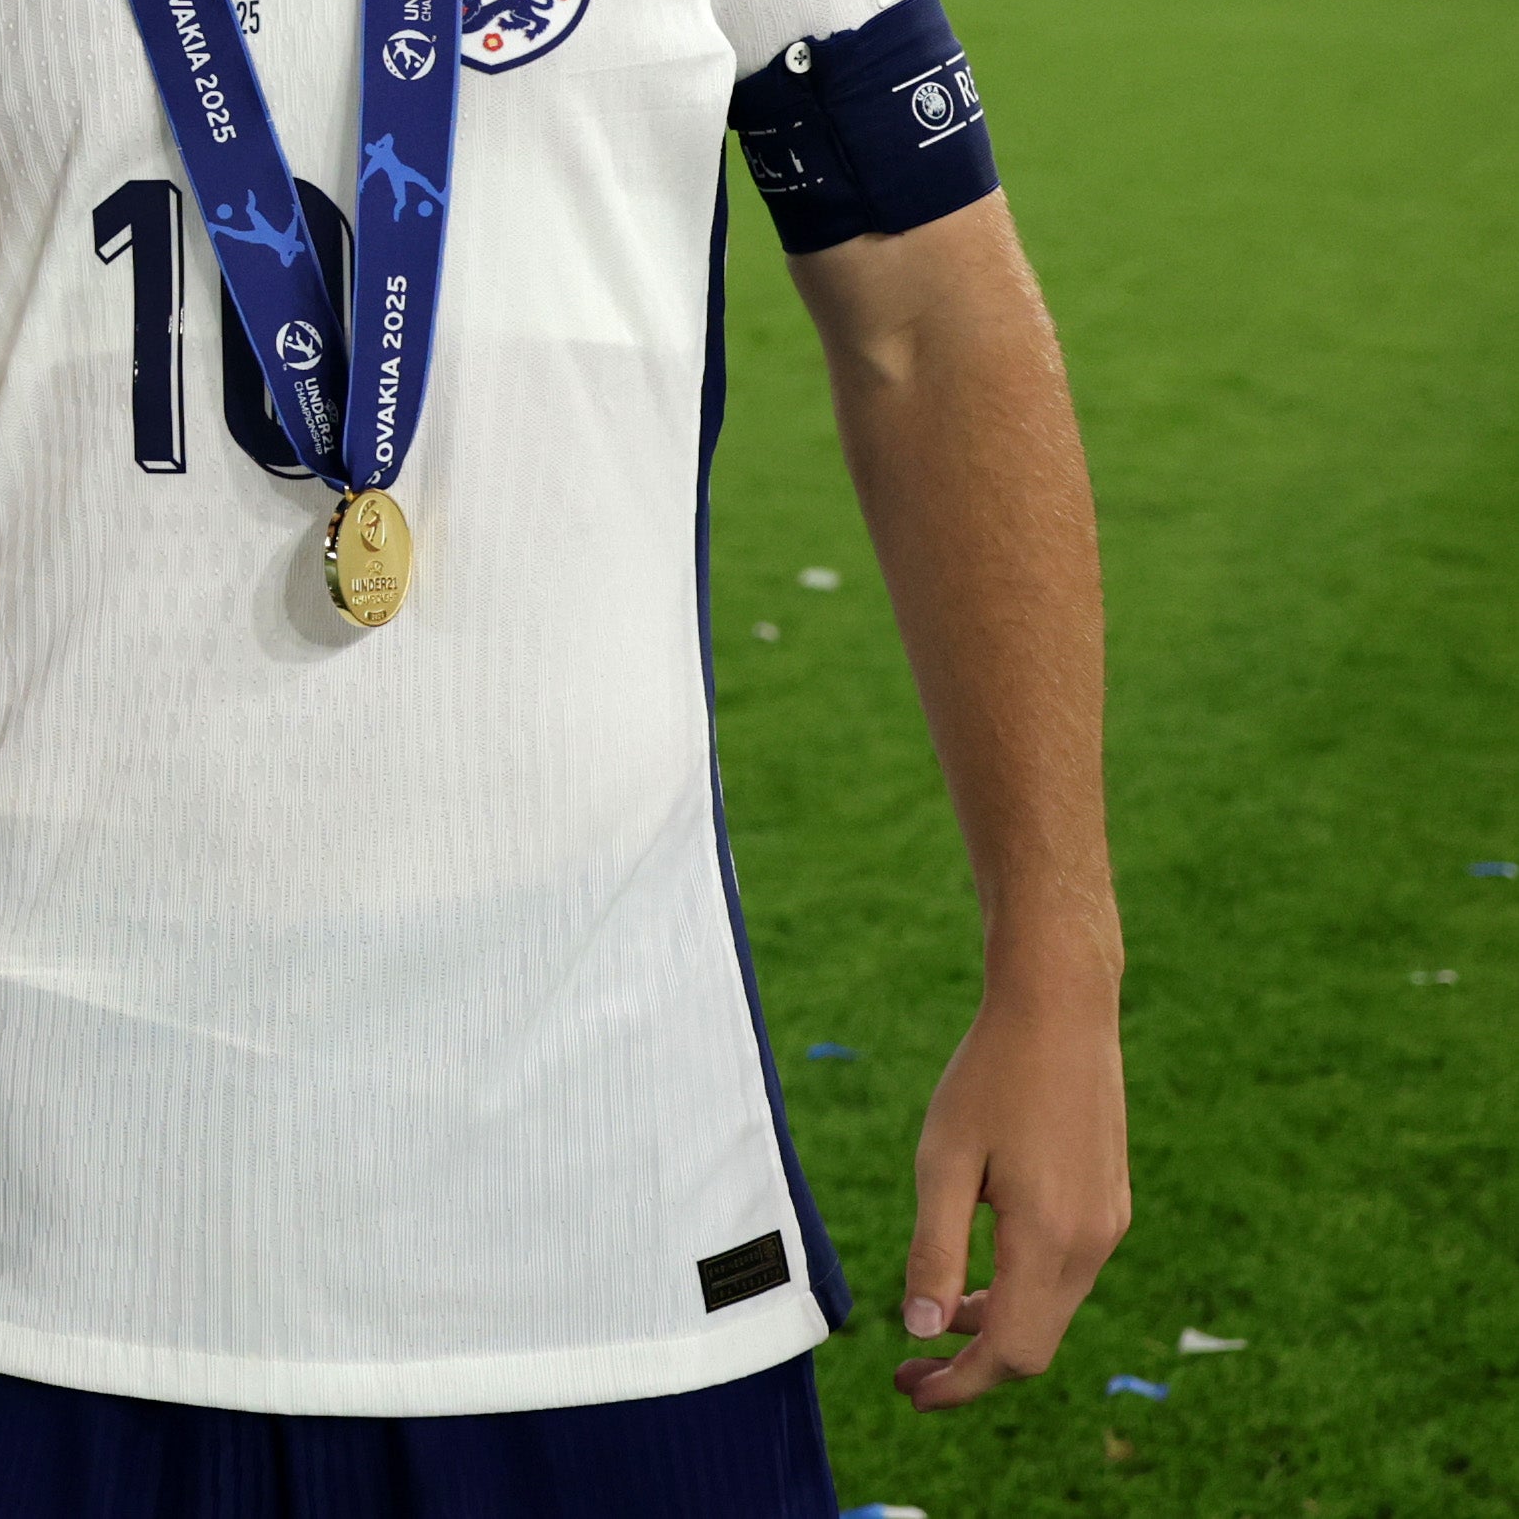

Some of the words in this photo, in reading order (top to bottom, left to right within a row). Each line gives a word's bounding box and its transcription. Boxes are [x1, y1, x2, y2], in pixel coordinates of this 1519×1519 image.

[195, 73, 237, 144] 2025
[916, 85, 940, 102] UEFA
[382, 275, 408, 350] 2025
[293, 381, 323, 455] CHAMPIONSHIP
[304, 377, 335, 455] UNDER21
[367, 356, 402, 485] OVAKIA
[351, 577, 398, 593] UNDER21
